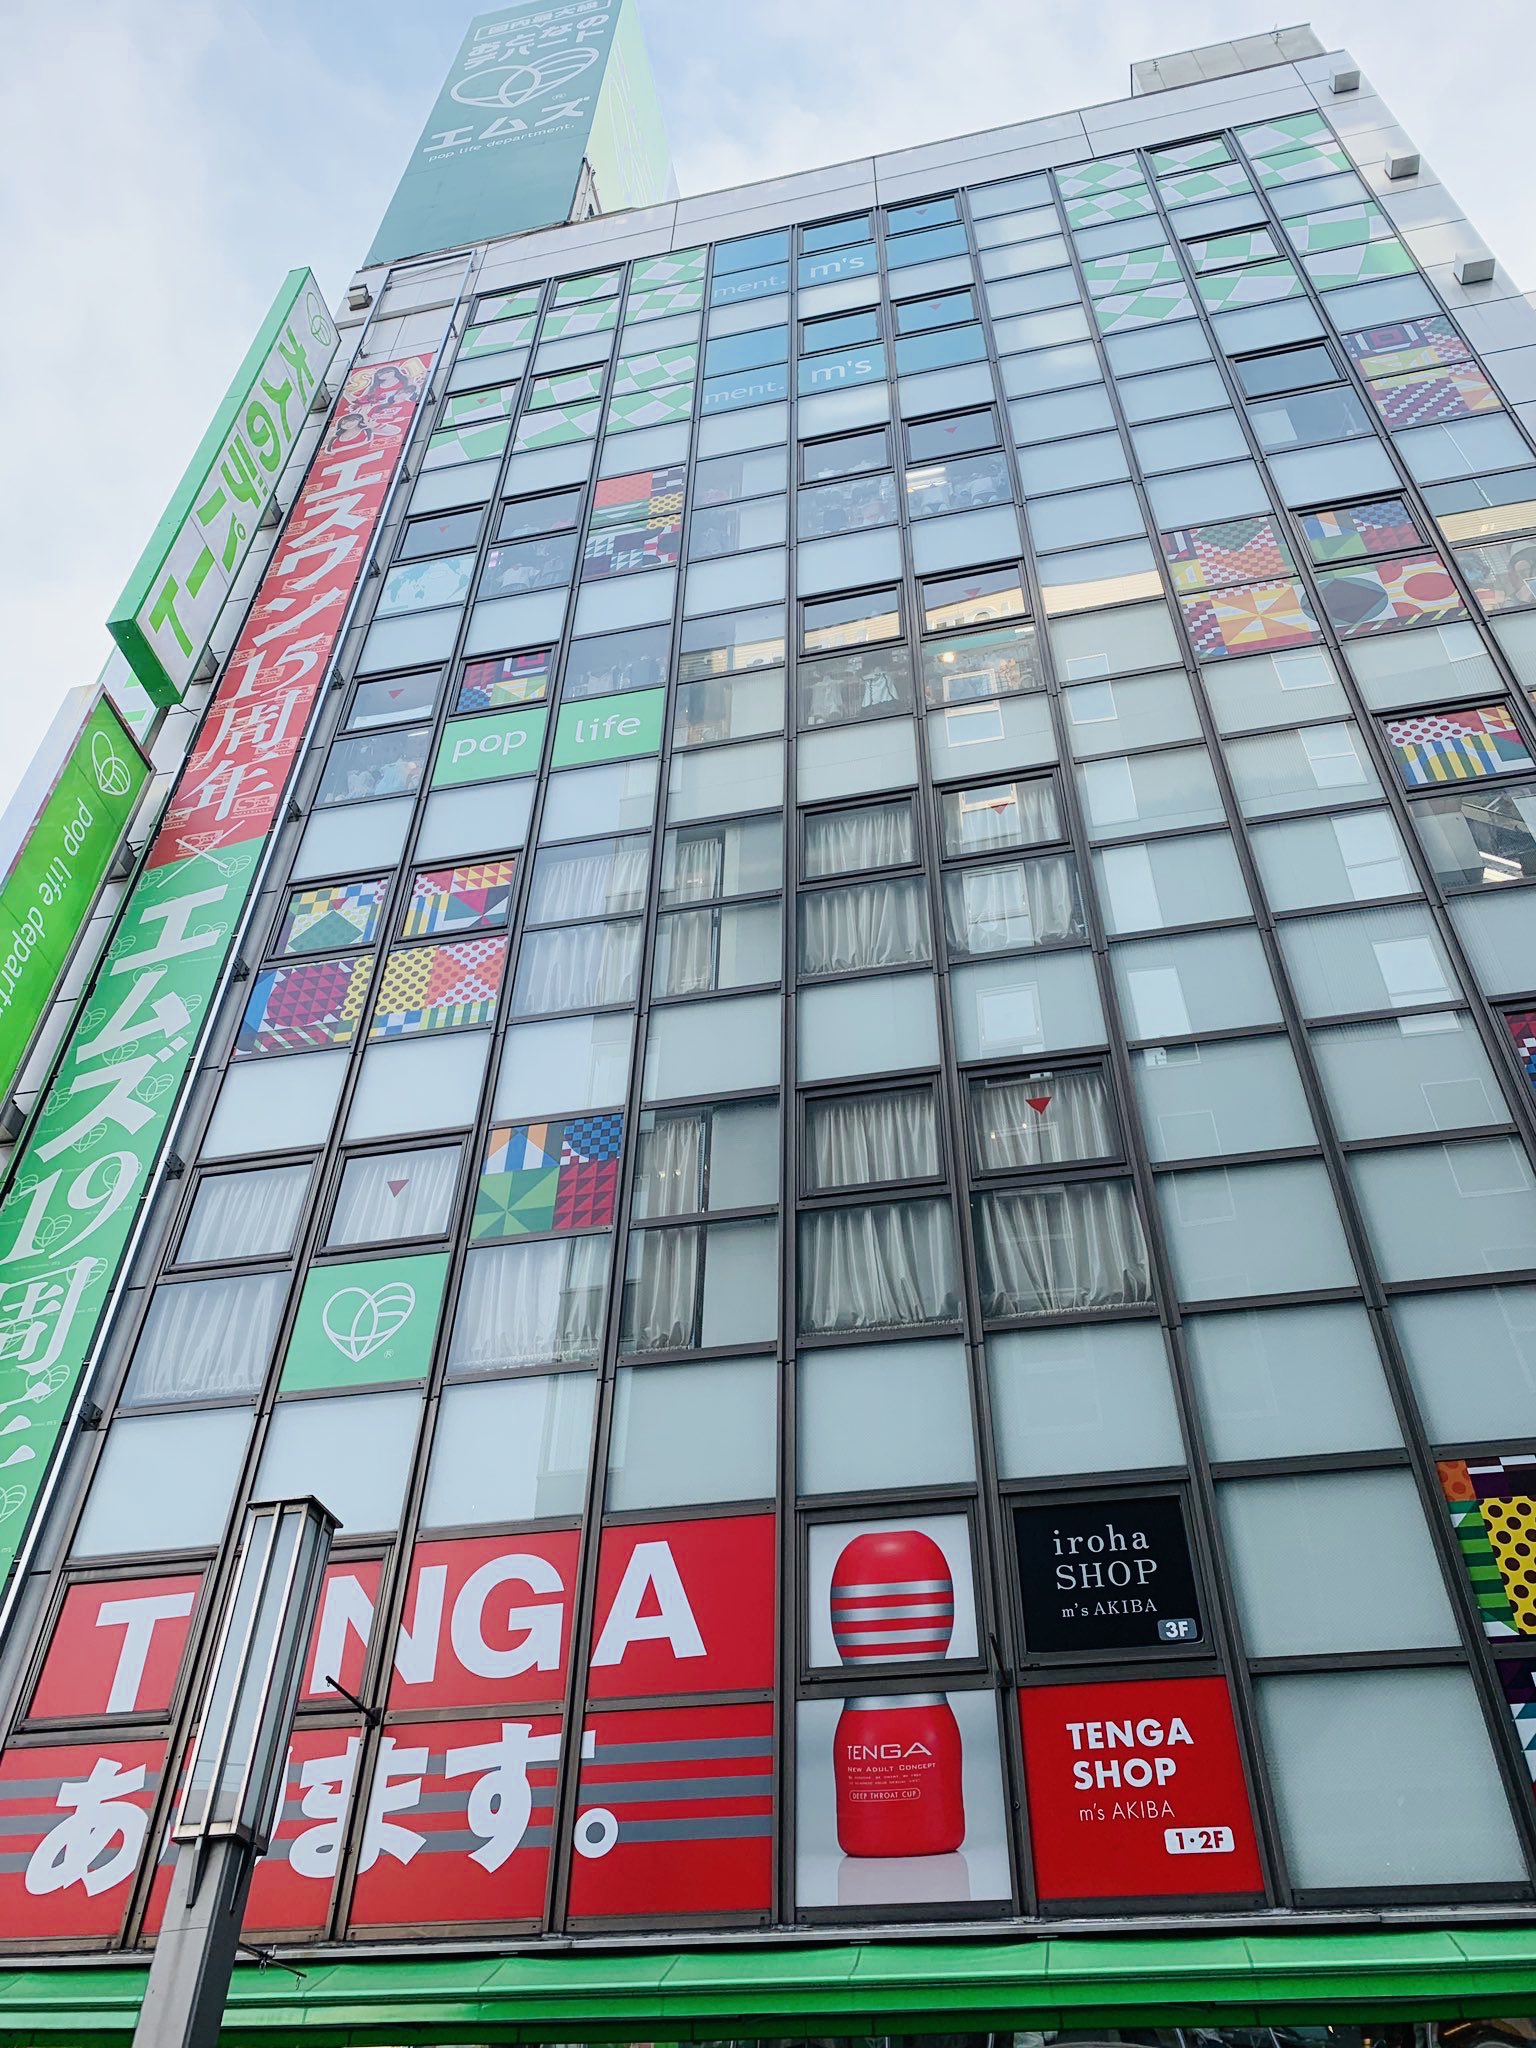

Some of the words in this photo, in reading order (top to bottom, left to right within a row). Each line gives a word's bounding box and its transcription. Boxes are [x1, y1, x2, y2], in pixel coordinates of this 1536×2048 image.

[468, 14, 610, 57] おとなの
[423, 96, 591, 152] エムズ
[428, 151, 455, 163] pop
[459, 145, 482, 155] life
[486, 123, 575, 148] department.
[713, 275, 786, 298] ment.
[810, 256, 865, 278] m's
[704, 381, 785, 404] ment.
[811, 360, 872, 384] m's
[148, 325, 315, 659] 大人のデパート
[451, 730, 528, 763] pop
[575, 714, 641, 743] life
[63, 797, 94, 856] pop
[38, 855, 72, 906] life
[1053, 1524, 1150, 1556] iroha
[1055, 1559, 1158, 1590] SHOP
[95, 1540, 707, 1713] TNGA
[1062, 1602, 1089, 1618] m's
[1093, 1598, 1158, 1616] AKIBA
[1165, 1620, 1189, 1639] 3F
[847, 1741, 932, 1760] TENGA
[1066, 1717, 1195, 1750] TENGA
[1073, 1757, 1177, 1790] SHOP
[24, 1722, 620, 1897] あます。
[852, 1792, 868, 1800] DEEP
[870, 1791, 898, 1800] THROAT
[901, 1790, 917, 1798] CUP
[1079, 1802, 1106, 1822] m's
[1112, 1799, 1176, 1820] AKIBA
